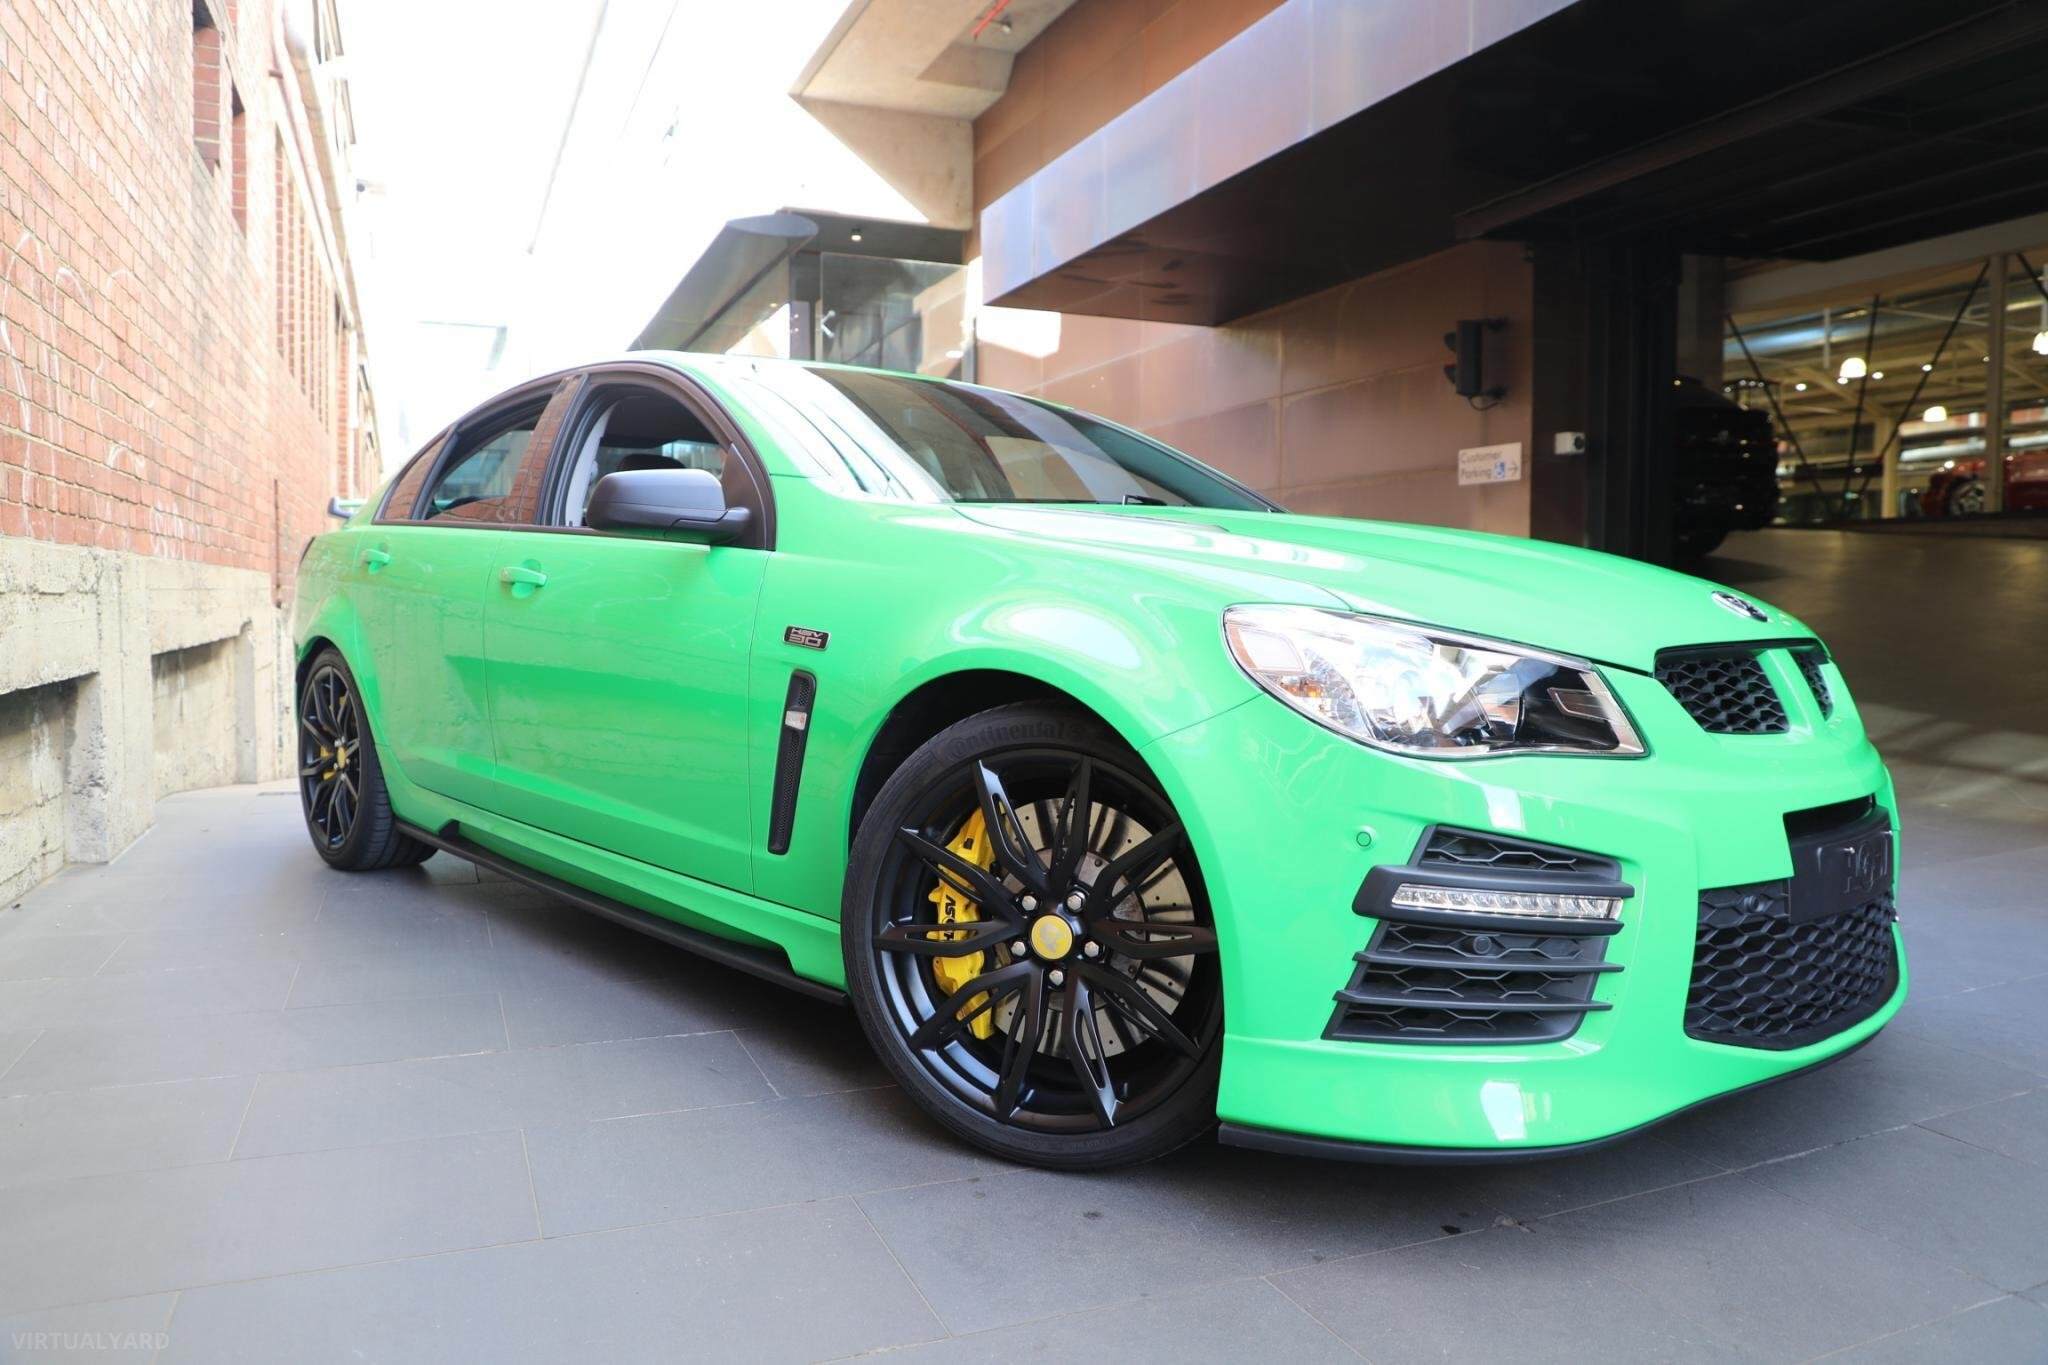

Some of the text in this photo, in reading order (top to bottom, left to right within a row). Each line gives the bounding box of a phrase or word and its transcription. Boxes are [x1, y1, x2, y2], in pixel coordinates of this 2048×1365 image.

[1460, 450, 1503, 464] Customer
[1461, 467, 1492, 480] Parking
[791, 627, 823, 637] HSV
[788, 634, 821, 648] 30
[946, 720, 1067, 759] Continental
